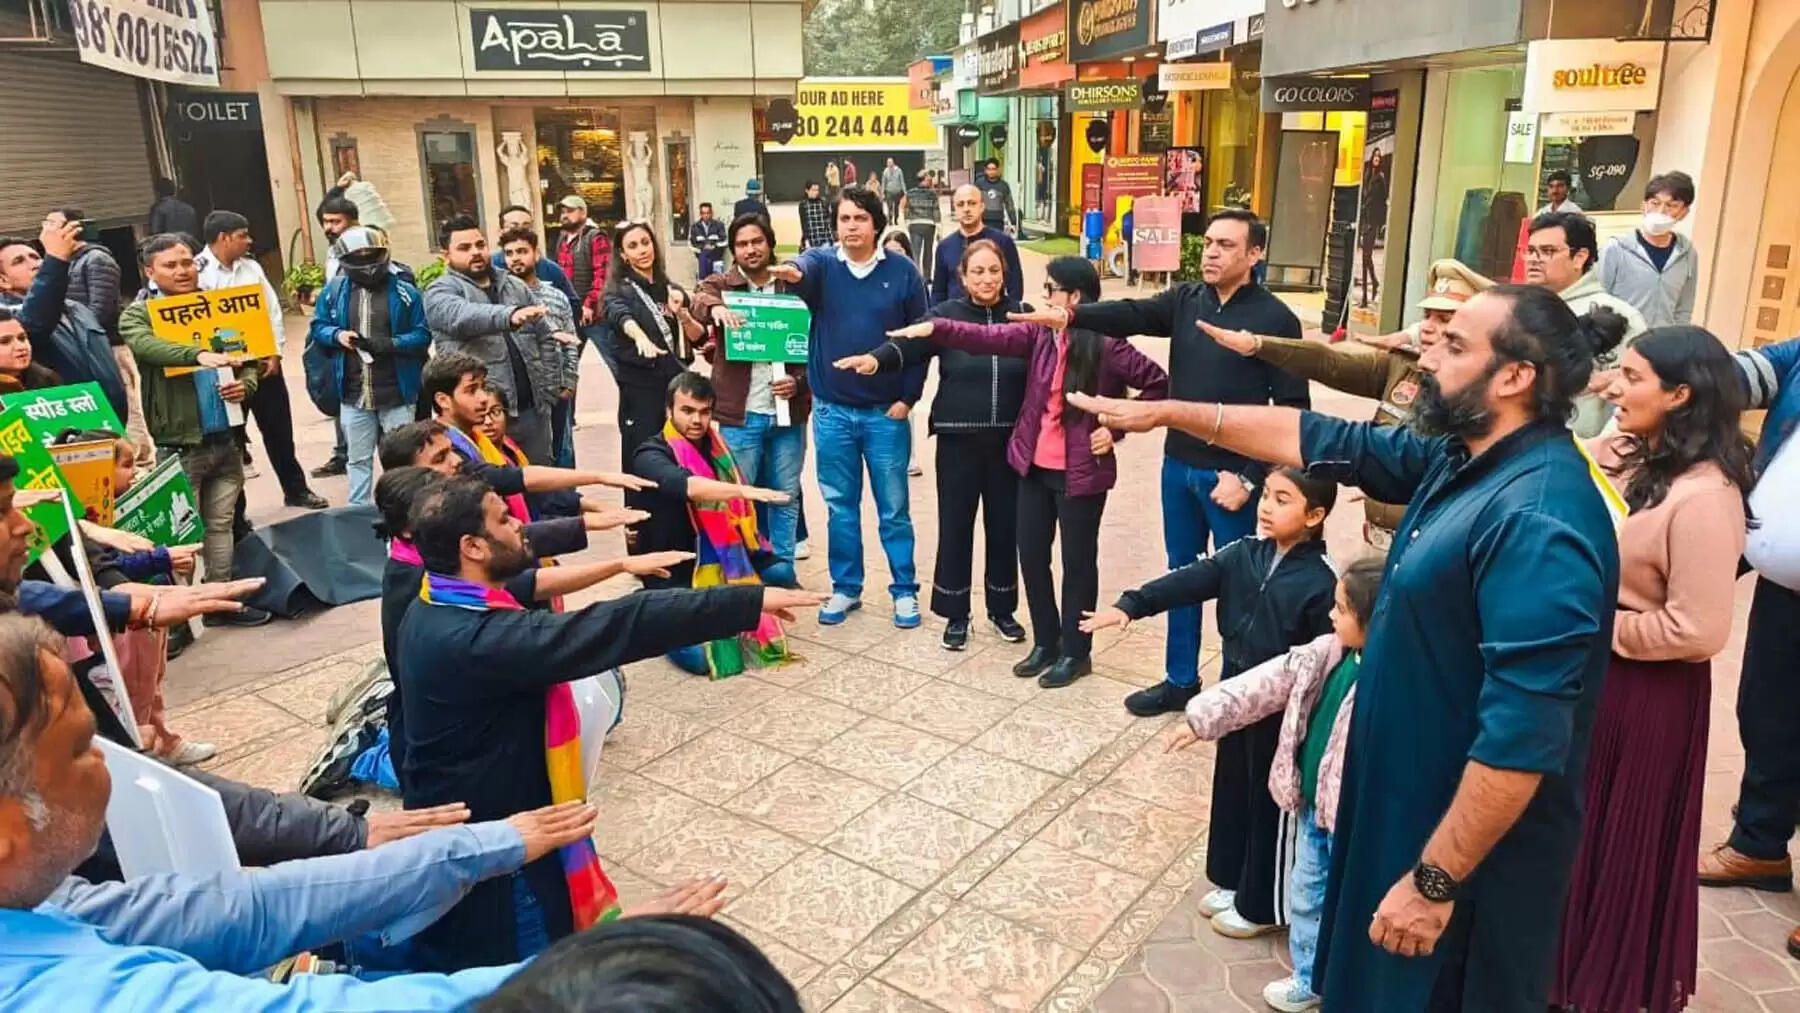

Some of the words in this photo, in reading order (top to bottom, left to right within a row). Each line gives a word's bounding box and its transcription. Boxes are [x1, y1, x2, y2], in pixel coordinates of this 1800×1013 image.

[70, 0, 214, 75] 9810015622
[796, 91, 826, 106] OUR
[831, 90, 848, 106] AD
[852, 90, 884, 106] HERE
[1071, 85, 1137, 100] DHIRSONS
[1274, 87, 1298, 103] GO
[1300, 87, 1355, 103] COLORS
[825, 116, 865, 137] 244
[871, 115, 909, 136] 444
[1588, 164, 1626, 179] SG-090
[1134, 228, 1178, 244] SALE
[158, 295, 212, 325] पहले
[218, 292, 260, 314] आप
[22, 396, 68, 420] स्पीड
[66, 389, 99, 413] स्लो
